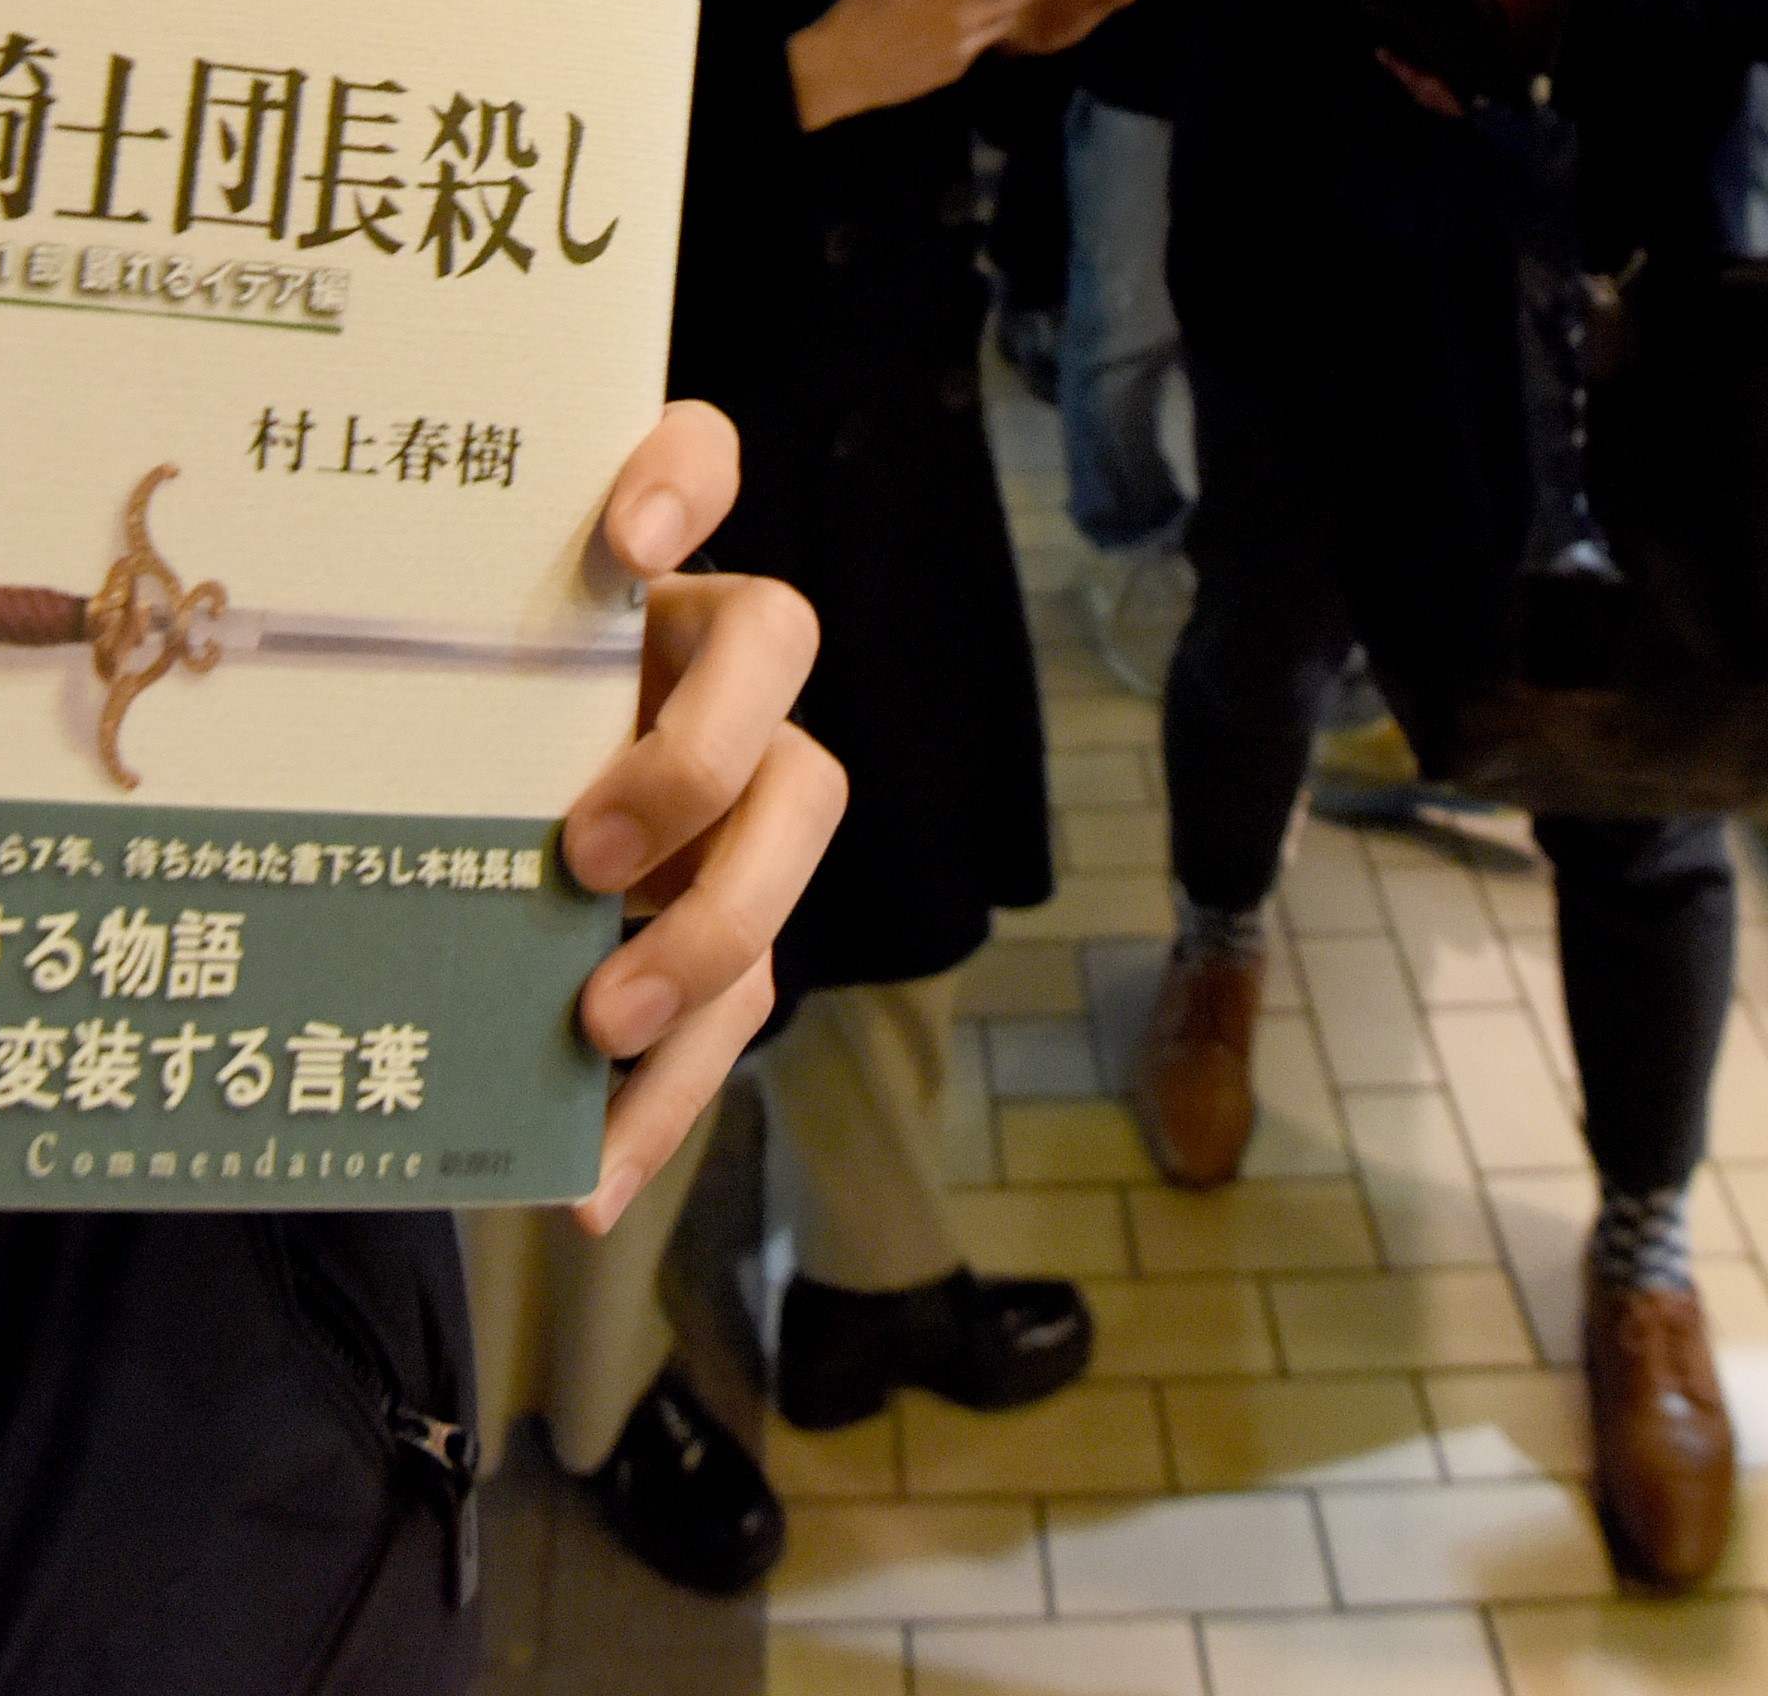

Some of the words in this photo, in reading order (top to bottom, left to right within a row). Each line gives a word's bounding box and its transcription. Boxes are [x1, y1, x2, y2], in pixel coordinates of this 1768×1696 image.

[244, 406, 522, 488] 村上春樹
[27, 1130, 425, 1180] Commendatore
